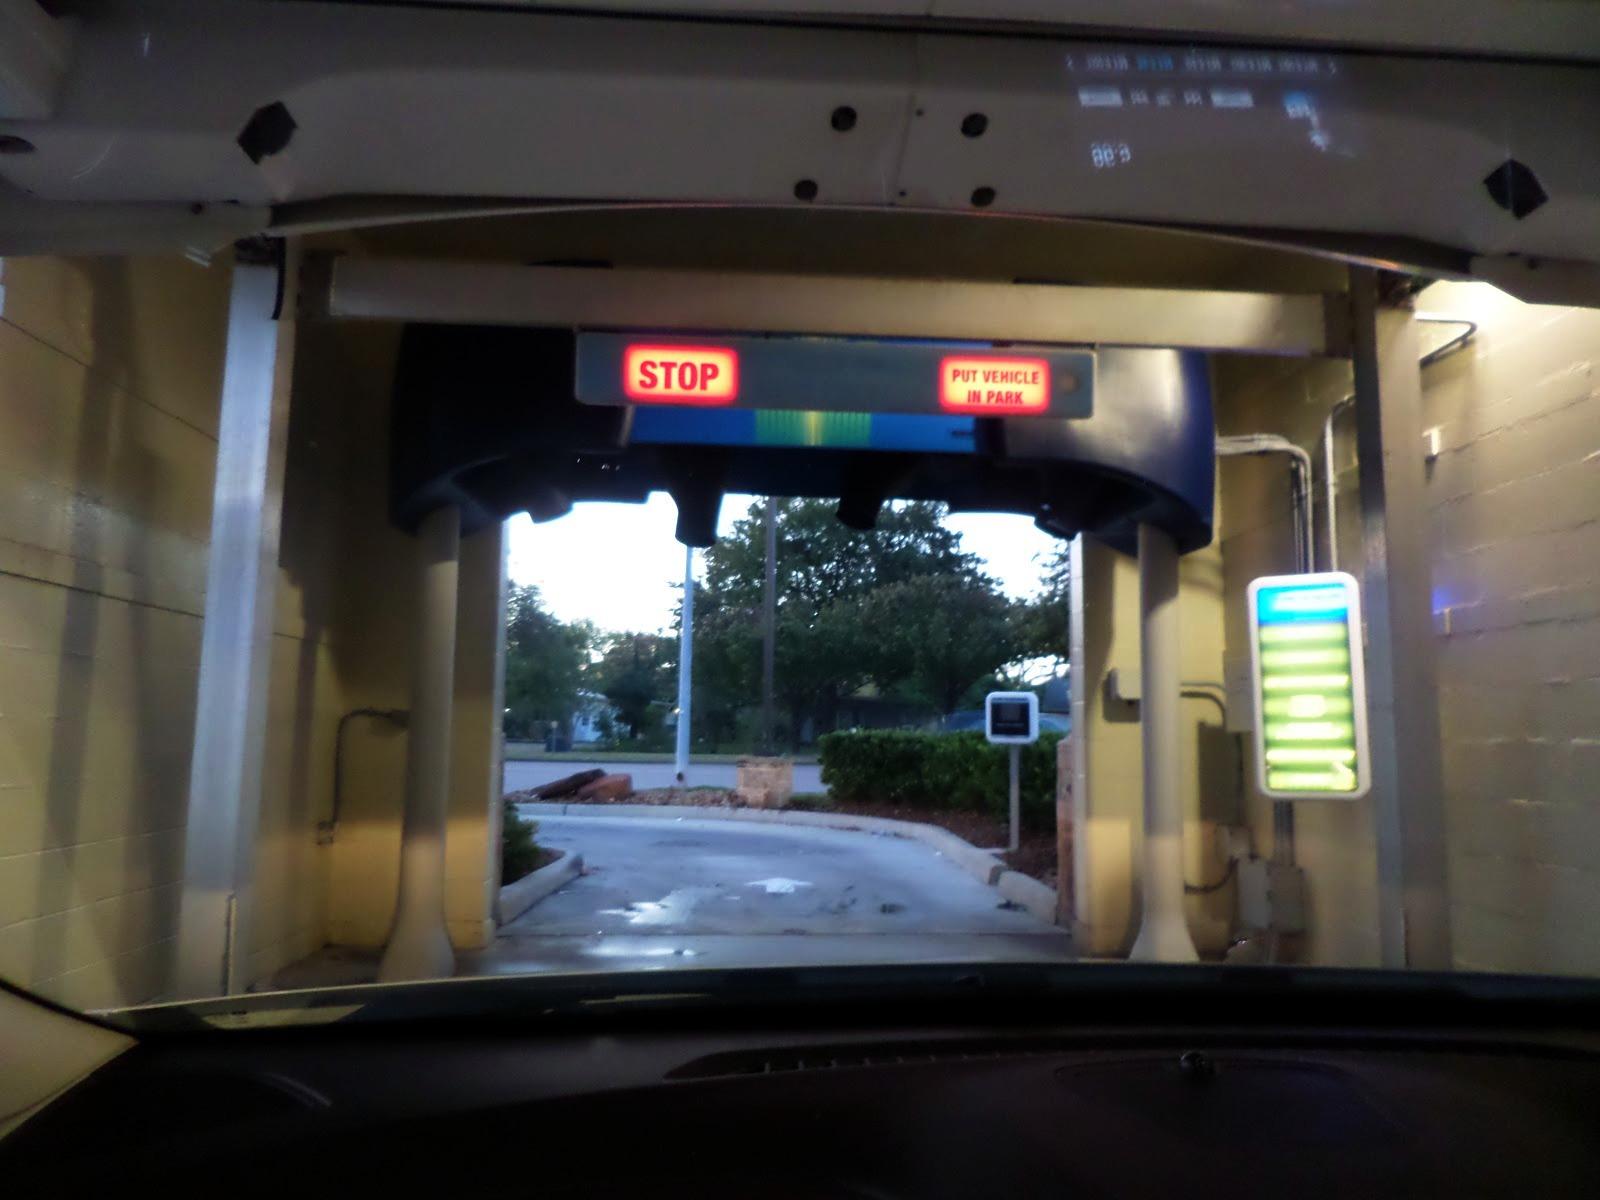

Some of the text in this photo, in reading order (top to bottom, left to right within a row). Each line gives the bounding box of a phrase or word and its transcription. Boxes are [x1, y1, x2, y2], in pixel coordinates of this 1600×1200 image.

[639, 360, 719, 391] STOP
[953, 369, 1040, 385] PUT VEHICLE
[967, 390, 1024, 404] IN PARK
